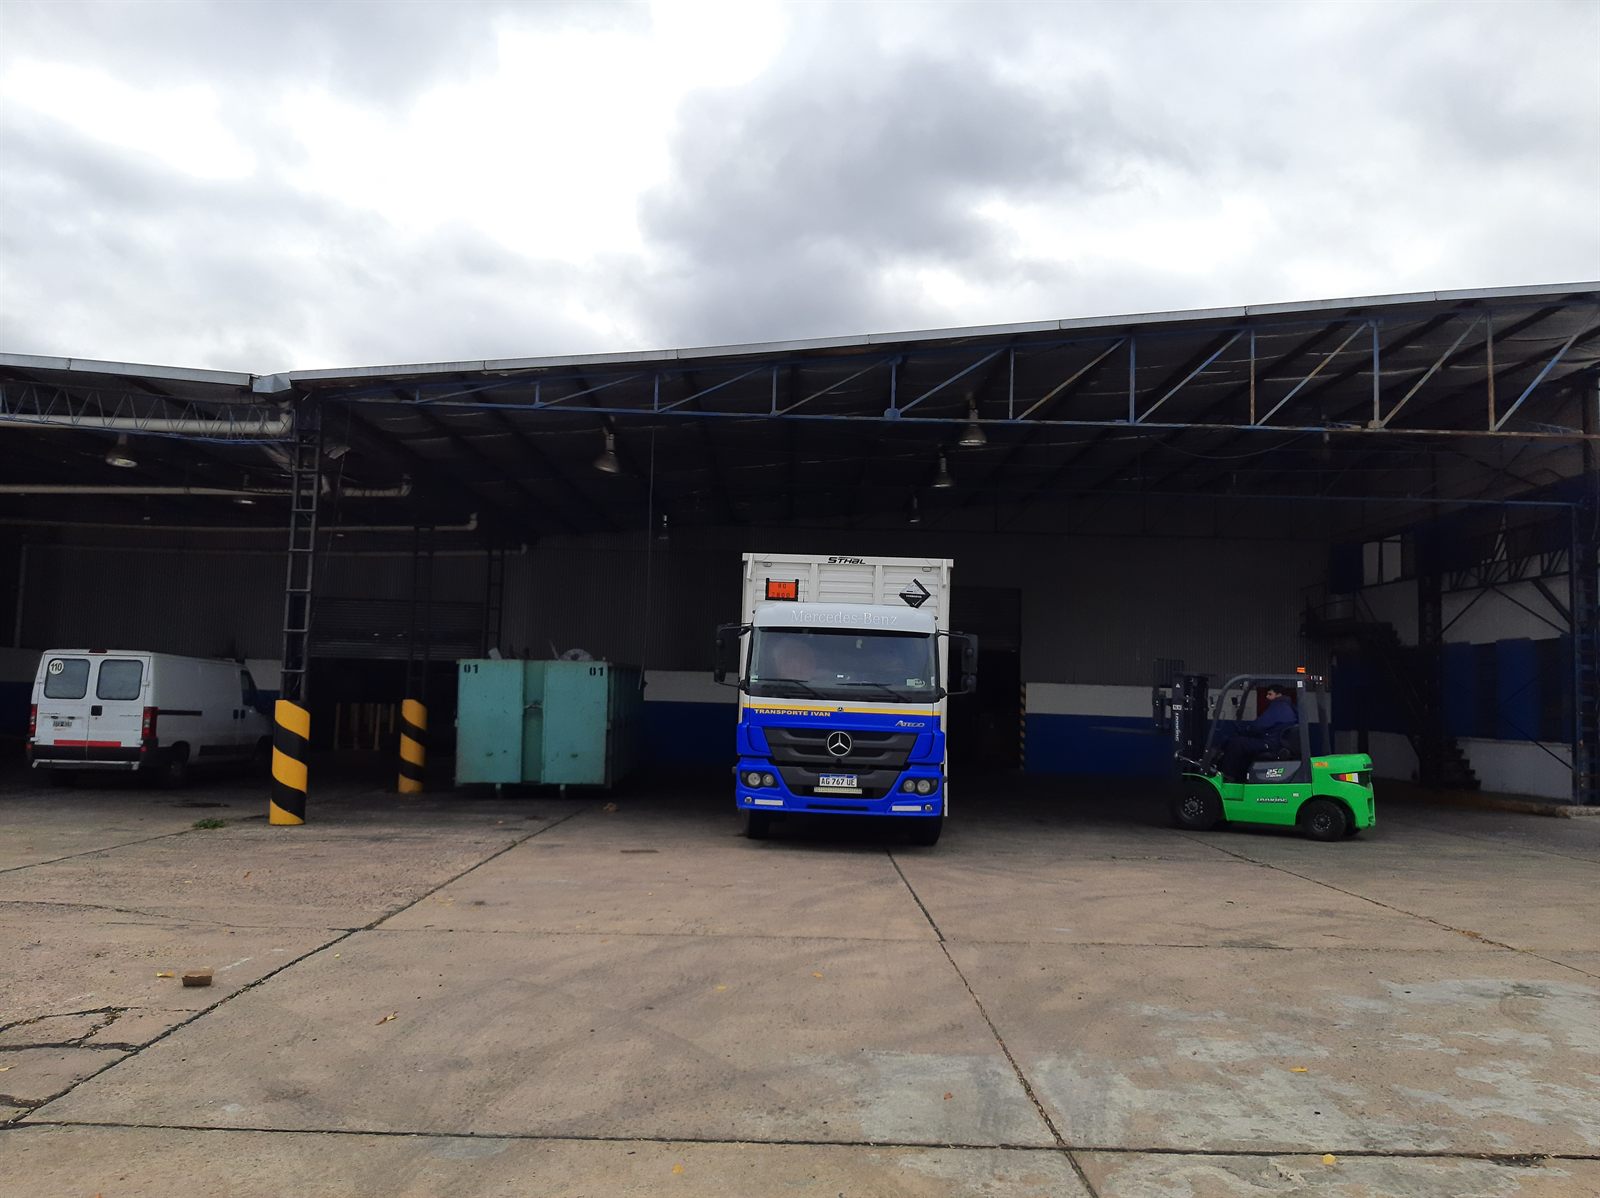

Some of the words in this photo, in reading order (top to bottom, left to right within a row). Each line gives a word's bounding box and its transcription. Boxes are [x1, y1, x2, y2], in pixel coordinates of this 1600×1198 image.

[791, 609, 898, 626] Mercedes-Benz
[51, 662, 62, 672] 110
[463, 664, 479, 674] 01
[589, 667, 604, 677] 01
[754, 708, 809, 717] TRANSPORTE
[820, 777, 830, 785] AG
[831, 778, 845, 786] 767
[846, 779, 856, 787] UE
